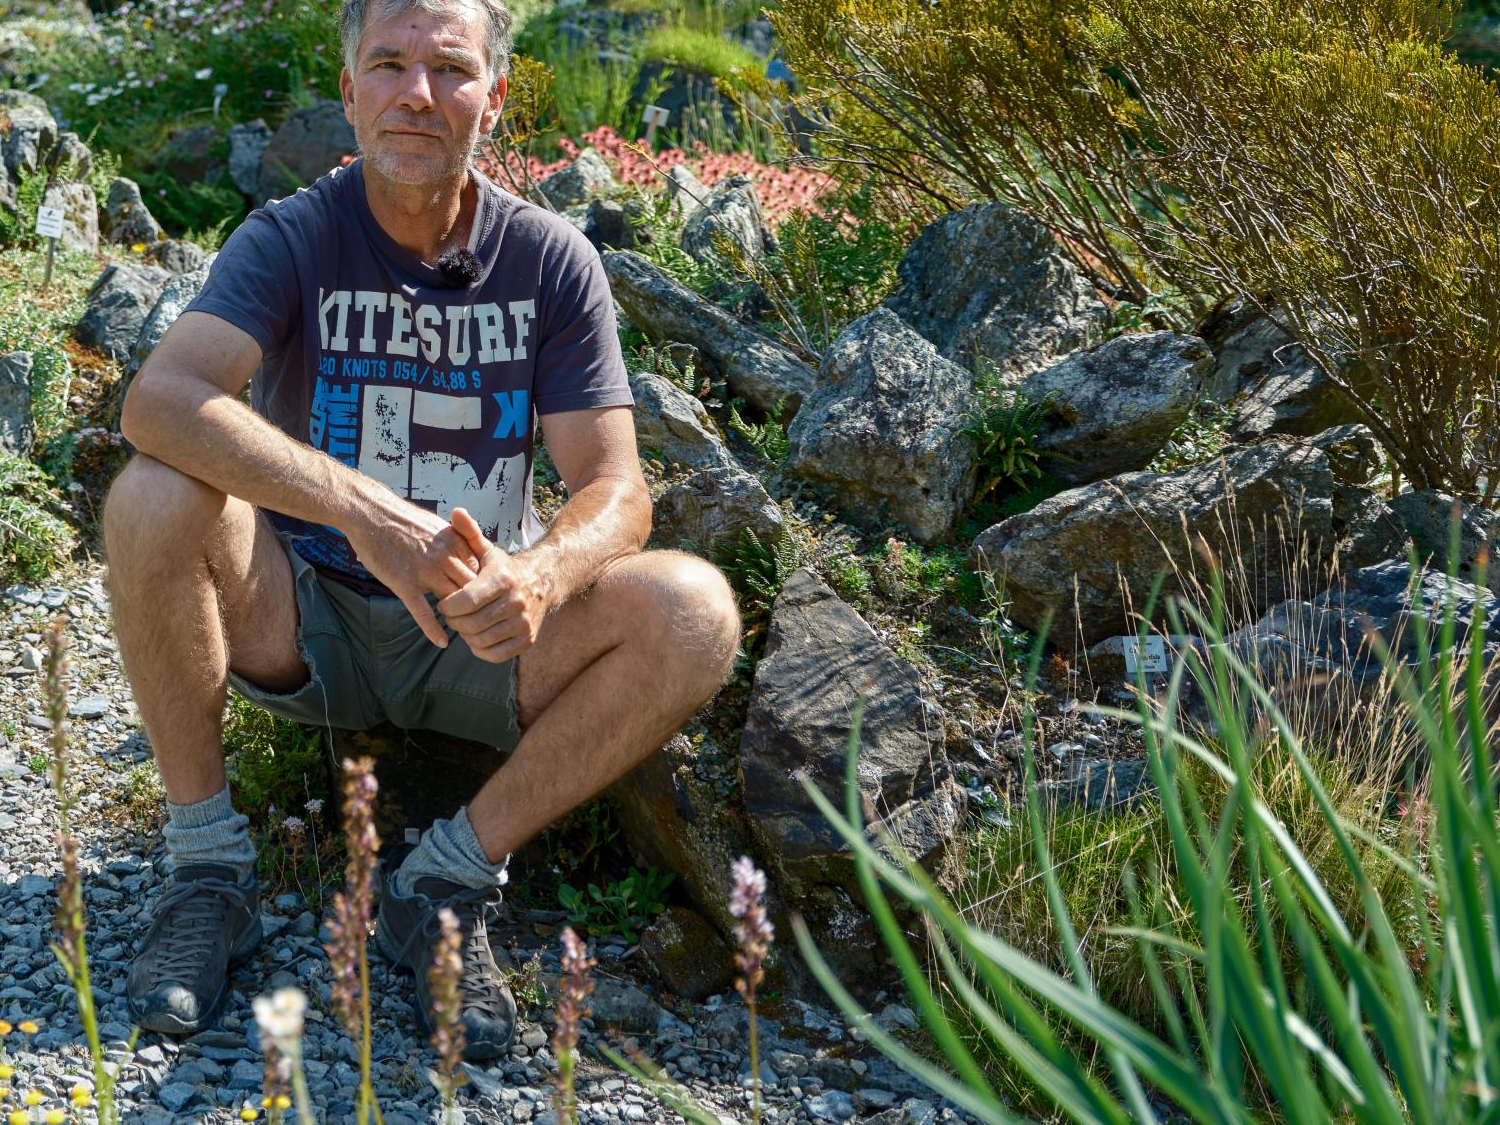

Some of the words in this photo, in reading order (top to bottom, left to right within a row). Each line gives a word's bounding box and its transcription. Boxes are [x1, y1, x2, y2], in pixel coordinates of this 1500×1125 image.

[318, 287, 536, 366] KITESURF
[342, 357, 388, 379] KNOTS
[471, 370, 482, 389] S
[327, 383, 359, 467] TIME
